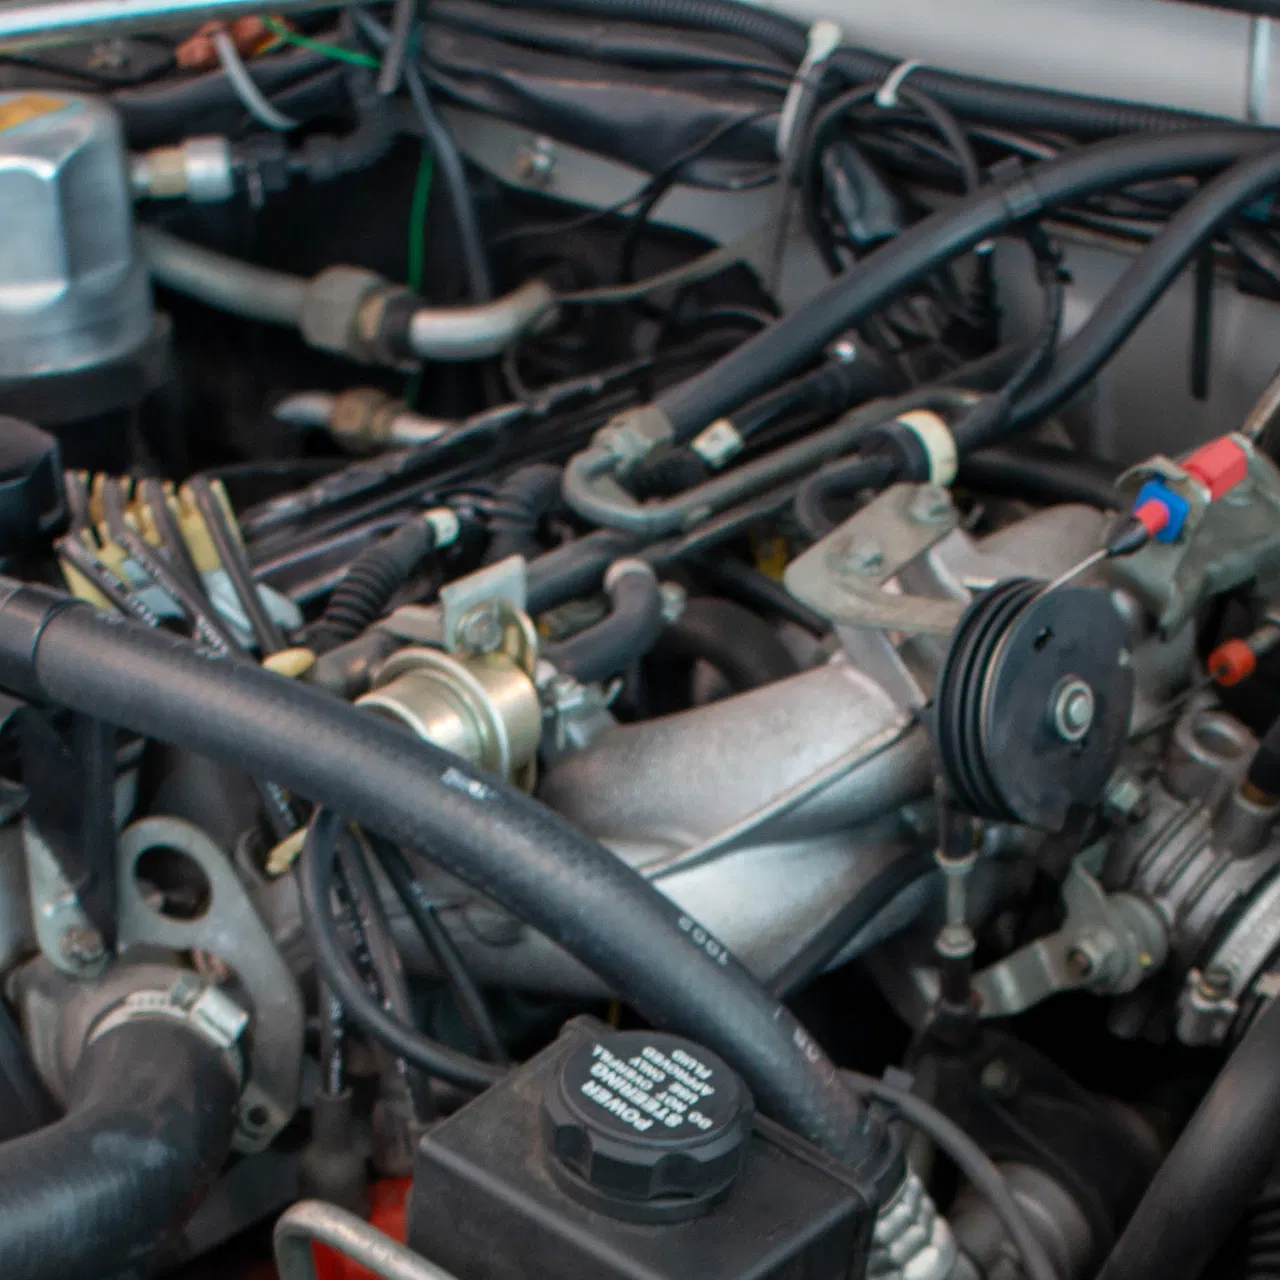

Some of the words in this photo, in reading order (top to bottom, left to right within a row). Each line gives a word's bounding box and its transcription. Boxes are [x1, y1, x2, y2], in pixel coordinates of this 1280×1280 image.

[593, 1045, 653, 1096] OVERFILL
[629, 1057, 666, 1082] ONLY
[642, 1047, 714, 1096] APPROVED
[672, 1050, 712, 1079] FLUID
[581, 1080, 653, 1131] POWER
[590, 1059, 683, 1127] STEERING
[654, 1091, 687, 1118] NOT
[668, 1082, 699, 1104] USE
[688, 1112, 713, 1129] DO
